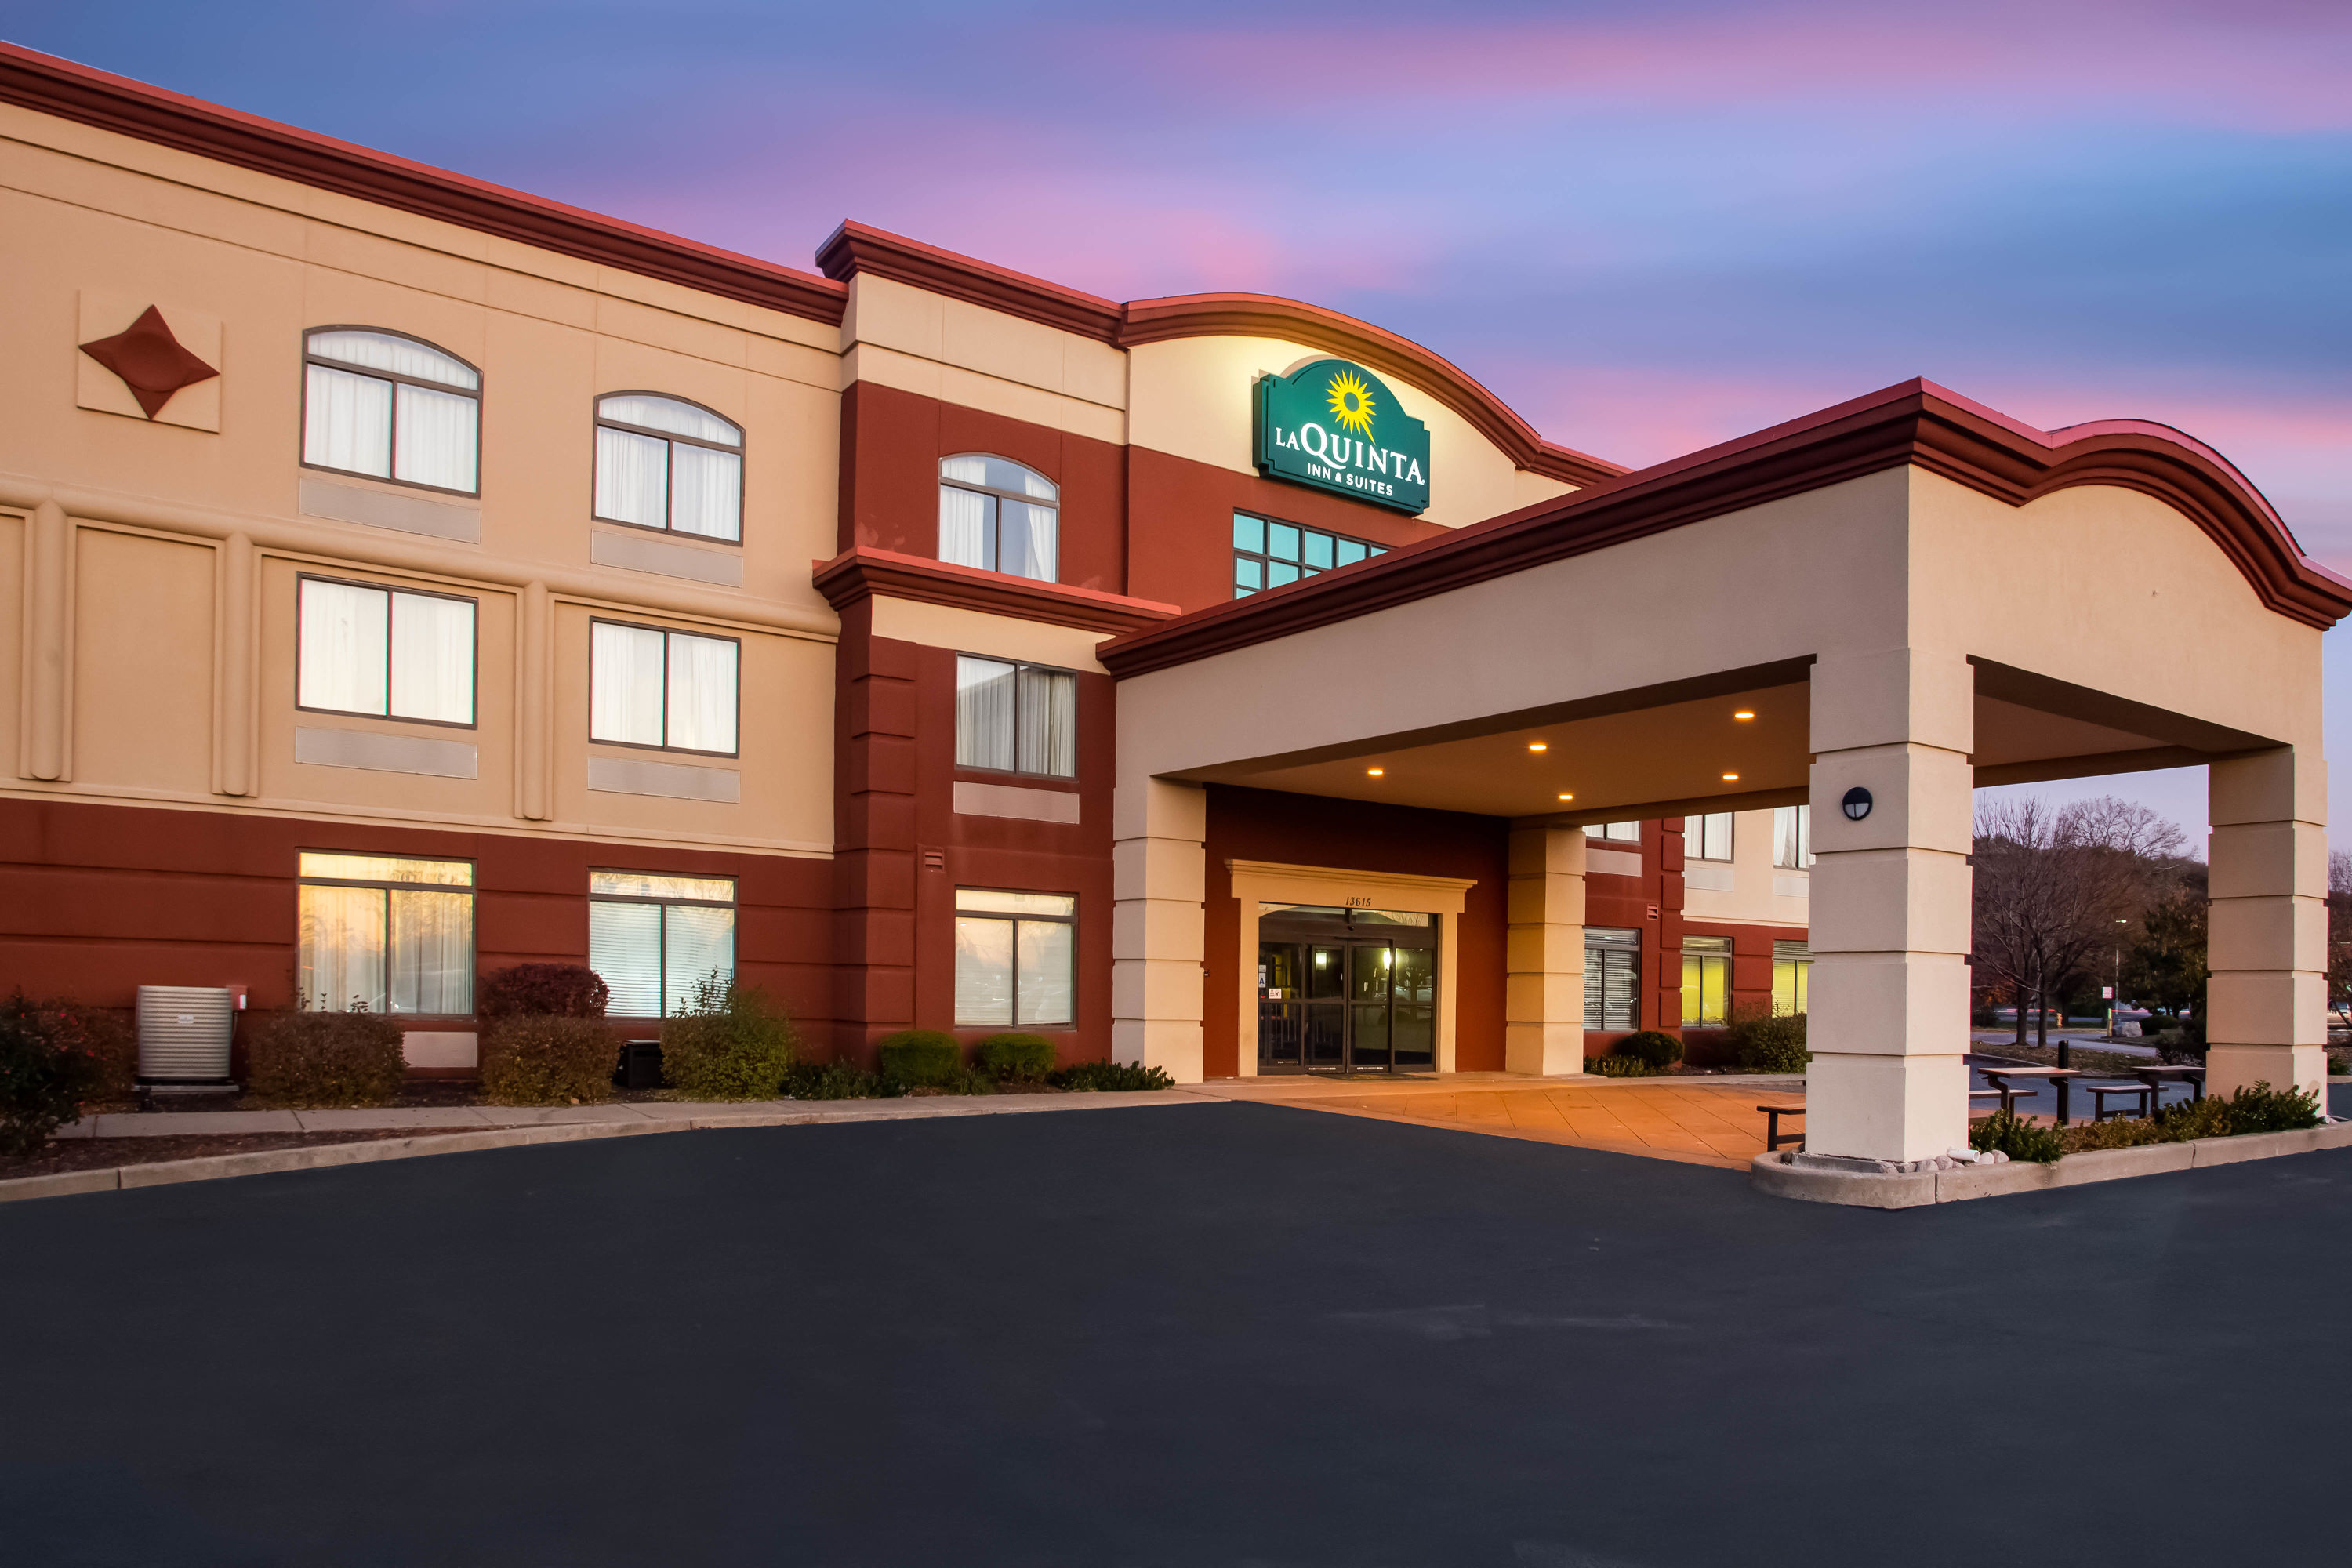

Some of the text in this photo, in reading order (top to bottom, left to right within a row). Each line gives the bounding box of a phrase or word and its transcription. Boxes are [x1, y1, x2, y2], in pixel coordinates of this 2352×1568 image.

[1275, 423, 1425, 485] LA QUINTA
[1307, 463, 1393, 496] INN & SUITES
[1345, 896, 1371, 907] 13615
